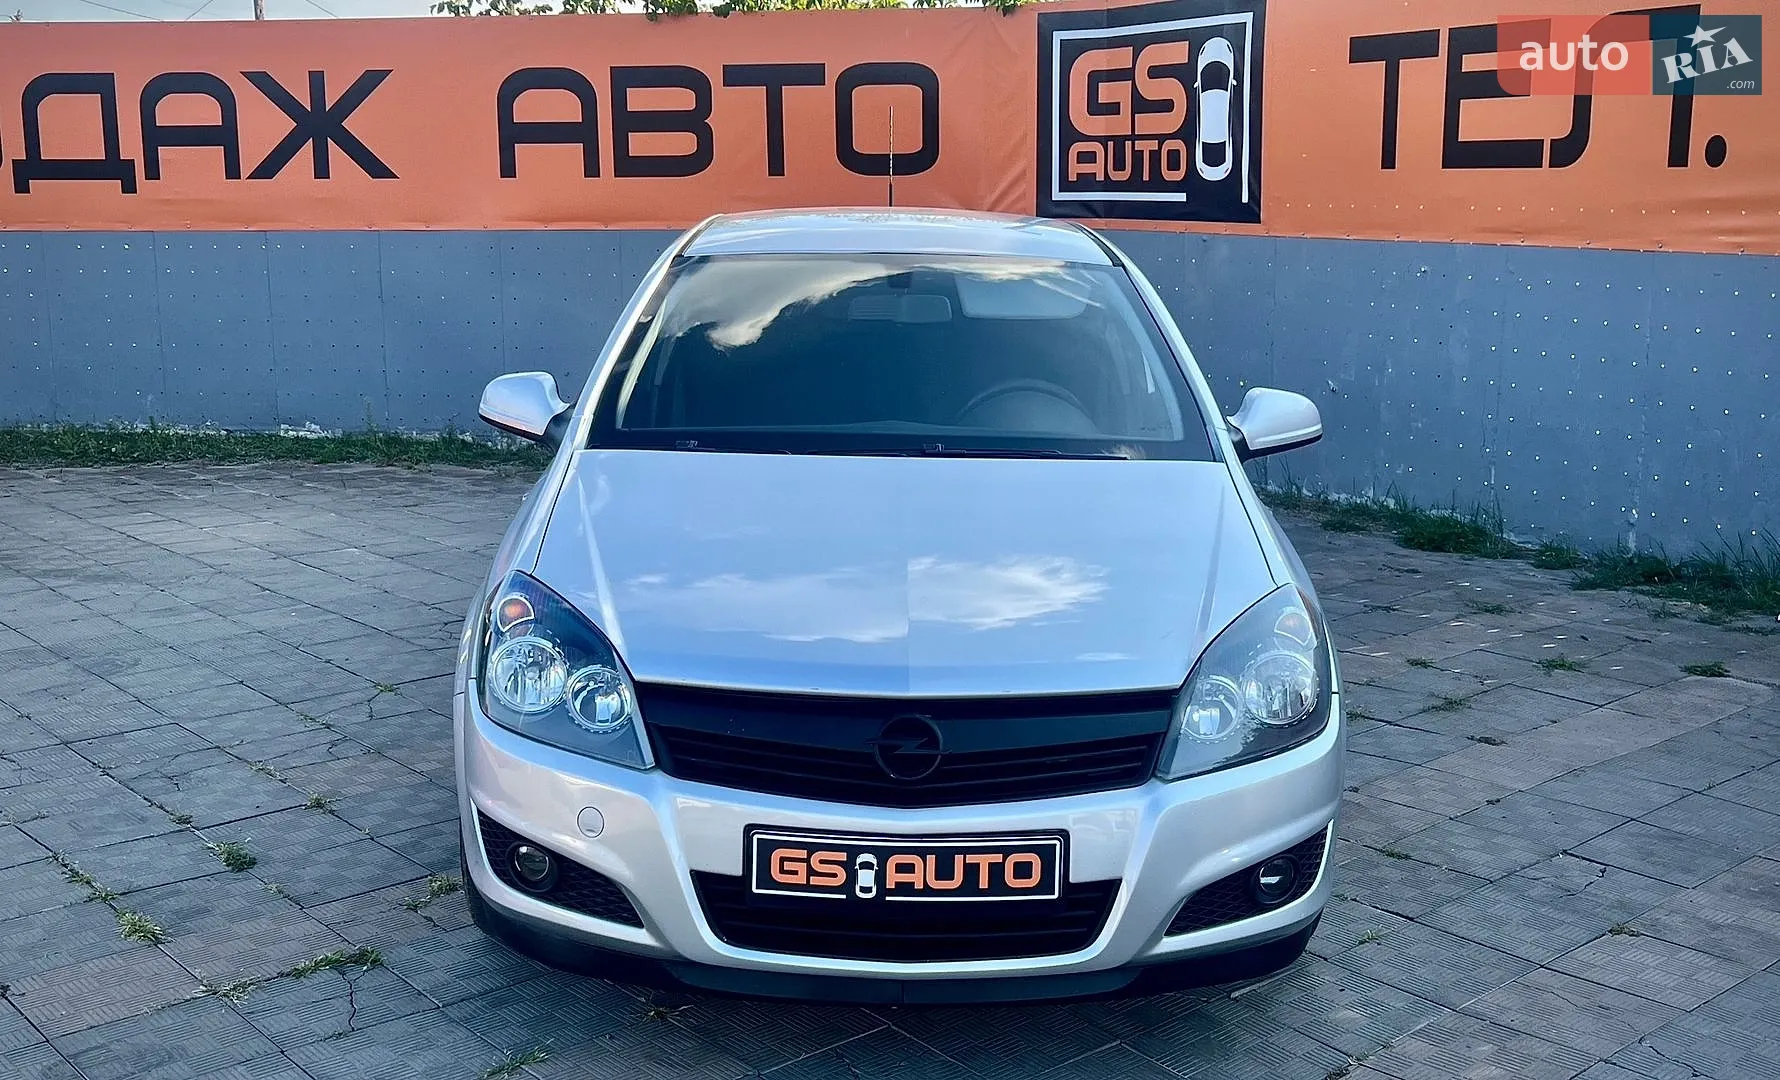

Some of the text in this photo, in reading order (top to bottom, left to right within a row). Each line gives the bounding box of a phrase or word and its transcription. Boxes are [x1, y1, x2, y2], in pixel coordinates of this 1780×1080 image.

[1069, 40, 1190, 136] GS
[0, 62, 940, 193] ДАЖ АВТО
[1068, 139, 1187, 182] AUTO
[770, 848, 1041, 889] GS AUTO
